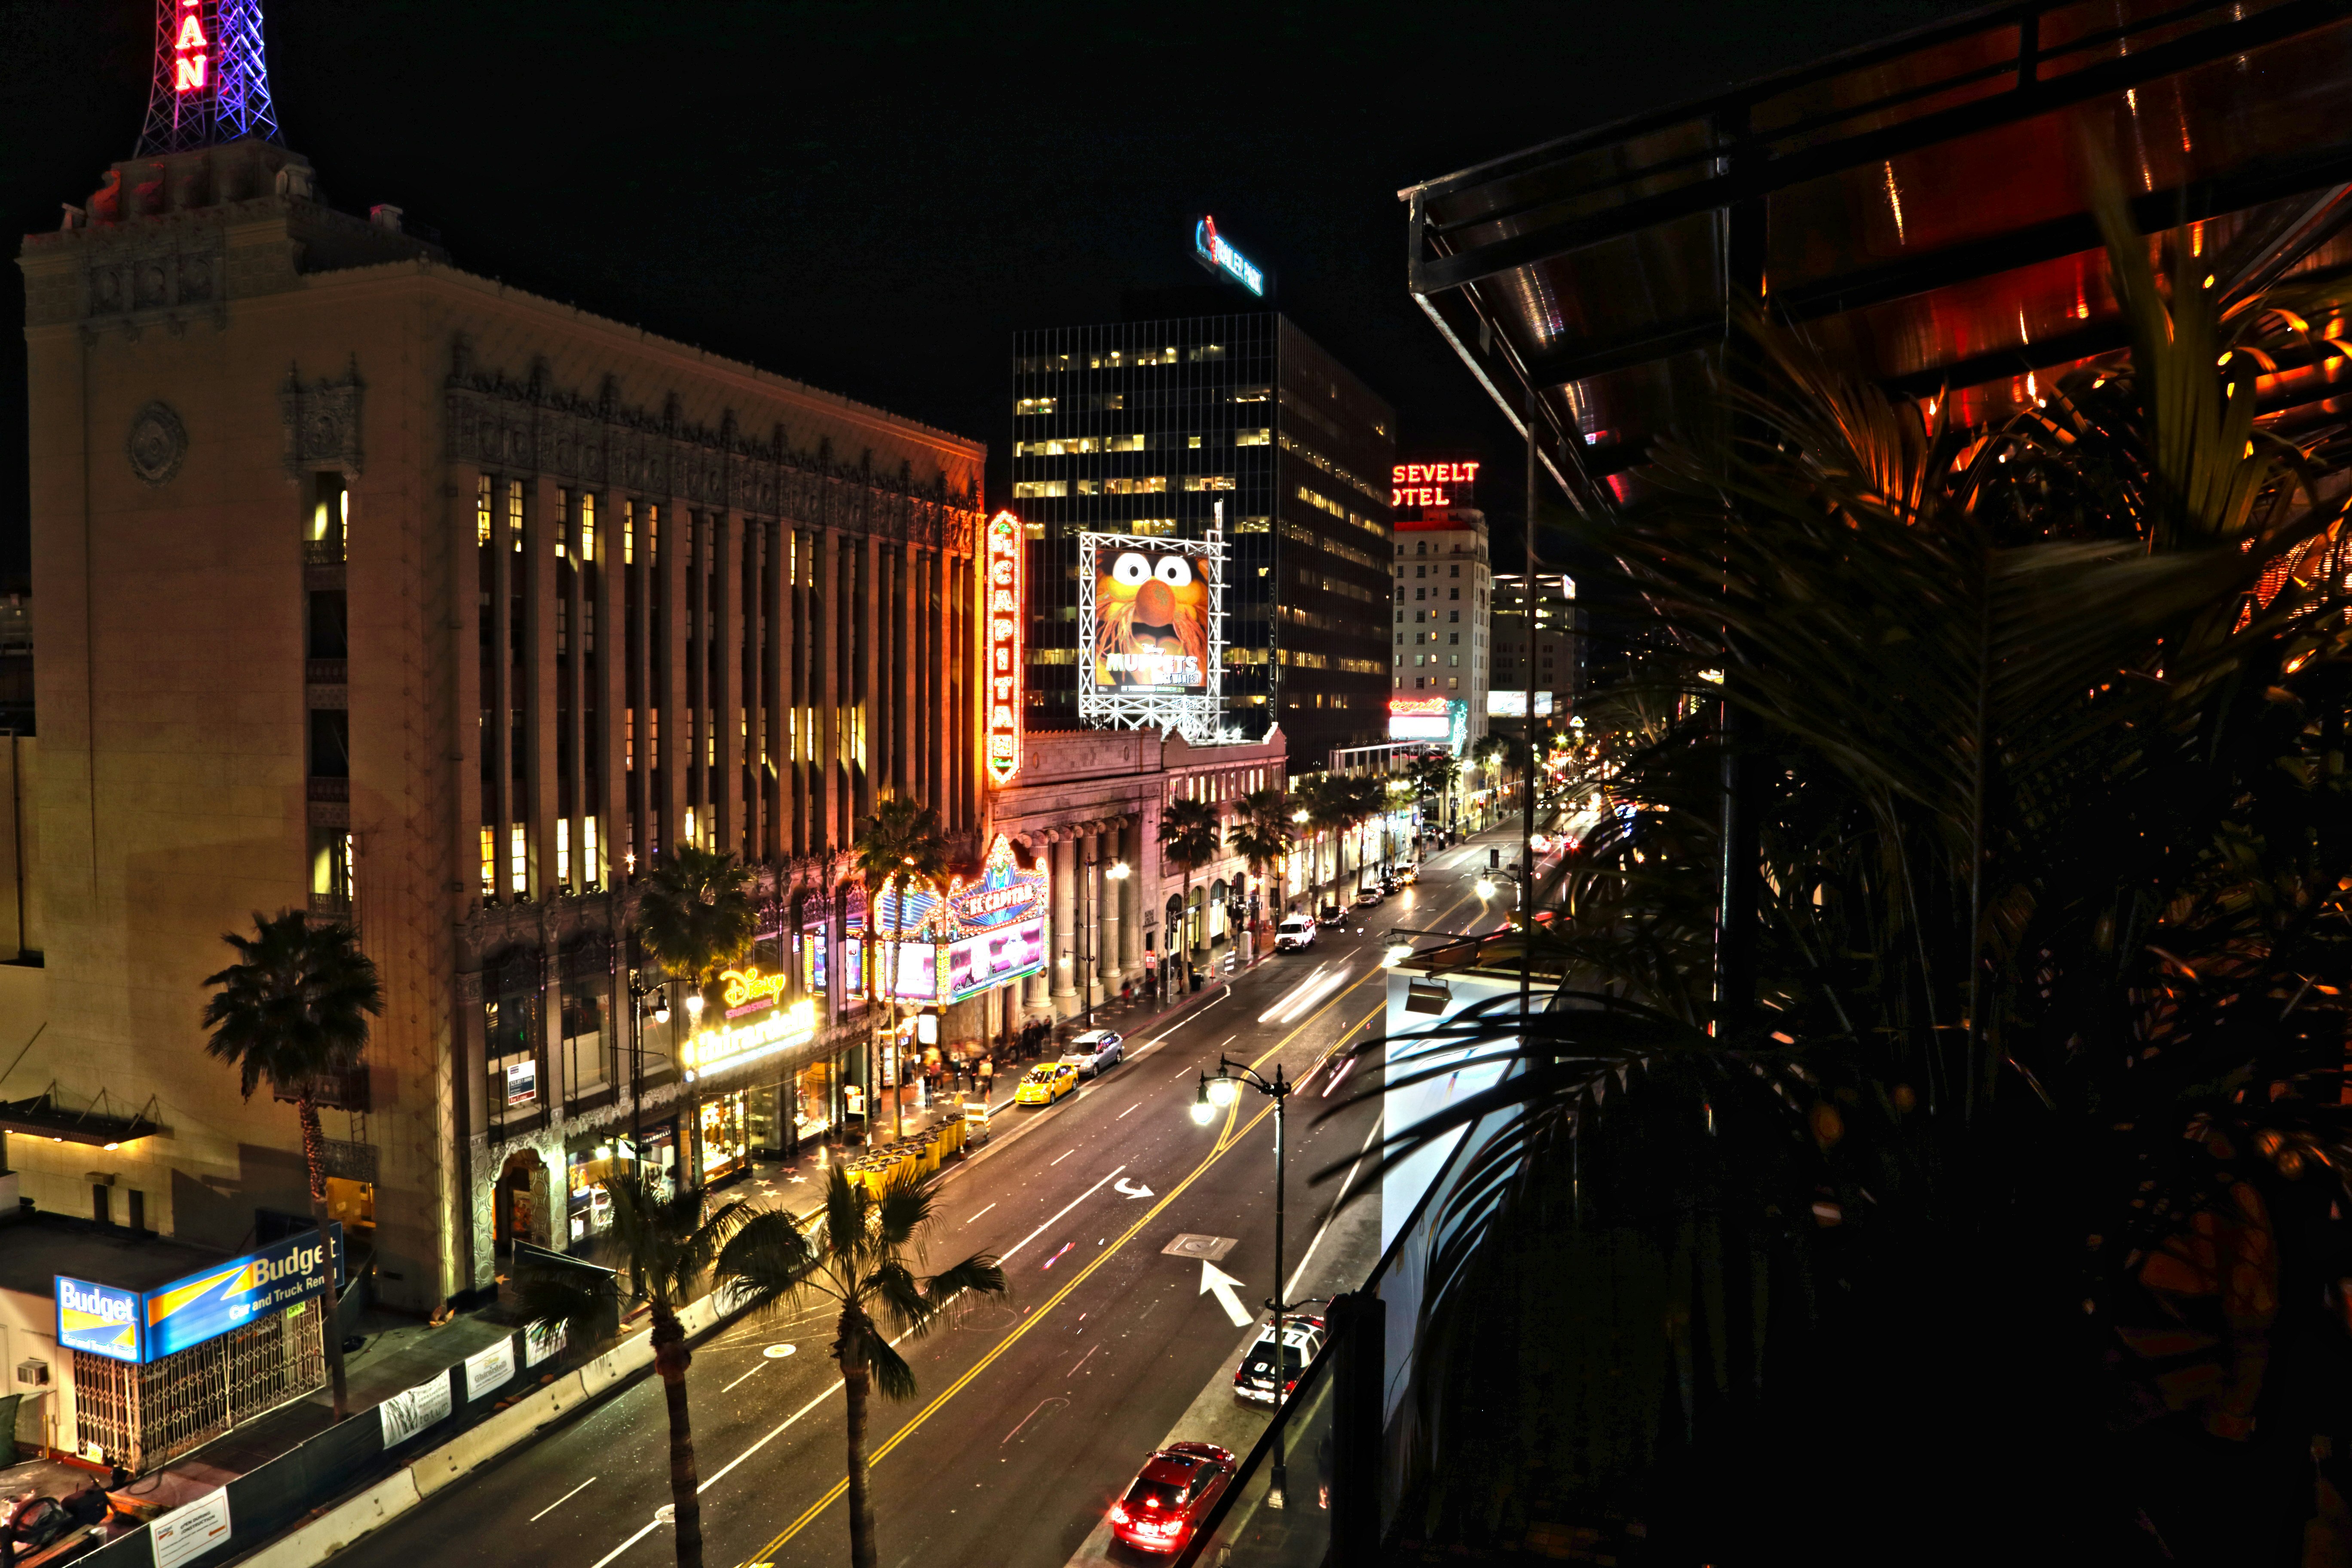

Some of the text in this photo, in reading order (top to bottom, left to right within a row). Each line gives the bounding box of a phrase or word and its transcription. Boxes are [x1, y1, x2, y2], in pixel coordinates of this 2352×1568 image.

[175, 0, 206, 90] AN
[1244, 260, 1262, 296] PARK
[1393, 462, 1479, 483] SEVELT
[1172, 673, 1199, 684] WANTED
[61, 1280, 135, 1323] Budget
[252, 1293, 272, 1311] and
[274, 1282, 303, 1302] Truck
[306, 1268, 337, 1290] Renl
[288, 1302, 304, 1314] OPEN
[420, 1403, 449, 1424] totum
